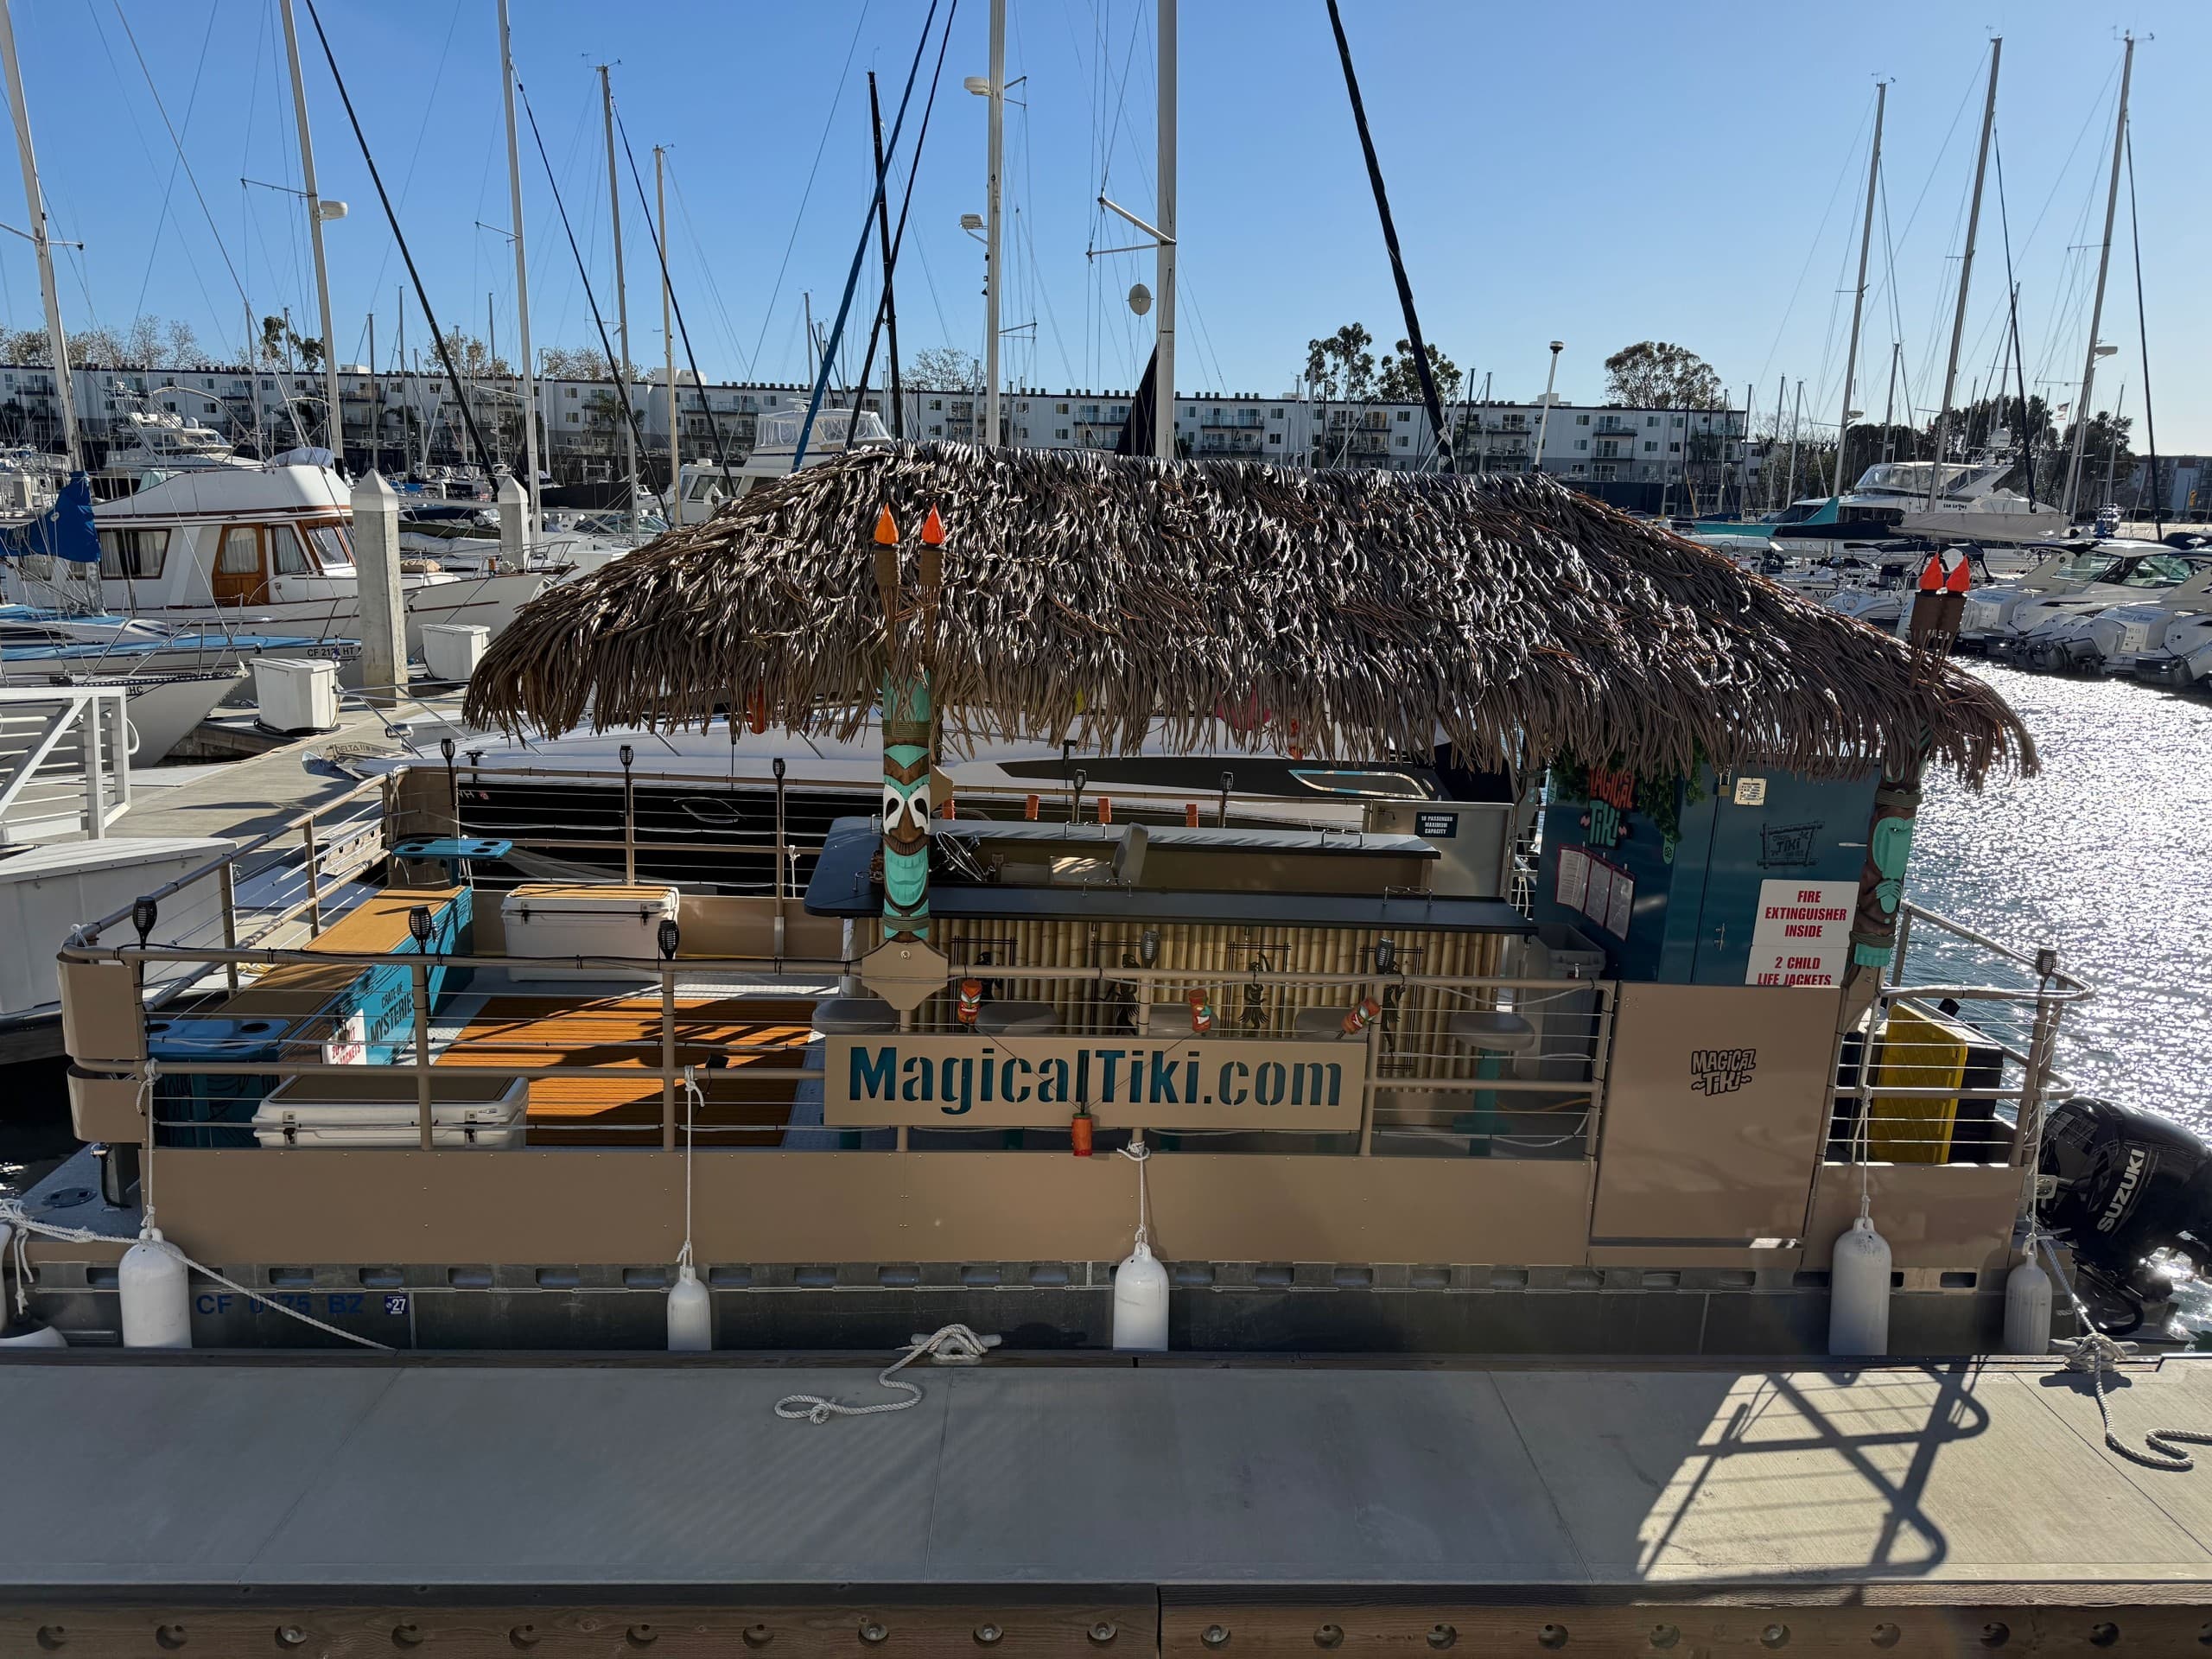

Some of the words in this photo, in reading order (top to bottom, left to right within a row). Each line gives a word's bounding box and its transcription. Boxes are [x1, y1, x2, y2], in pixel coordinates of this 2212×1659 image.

[1797, 891, 1821, 903] FIRE
[1765, 907, 1847, 921] EXTINGUISHER
[1784, 925, 1823, 938] INSIDE
[1775, 957, 1783, 969] 2
[1787, 957, 1821, 969] CHILD
[1758, 973, 1780, 985] LIFE
[1783, 974, 1832, 986] JACKETS
[381, 987, 397, 1009] CRATE
[397, 981, 403, 995] OF
[849, 1046, 1342, 1115] MagicalTiki.com
[2097, 1148, 2146, 1233] SUZUKI
[196, 1294, 232, 1314] CF
[328, 1294, 366, 1314] BZ
[392, 1298, 406, 1311] 27
